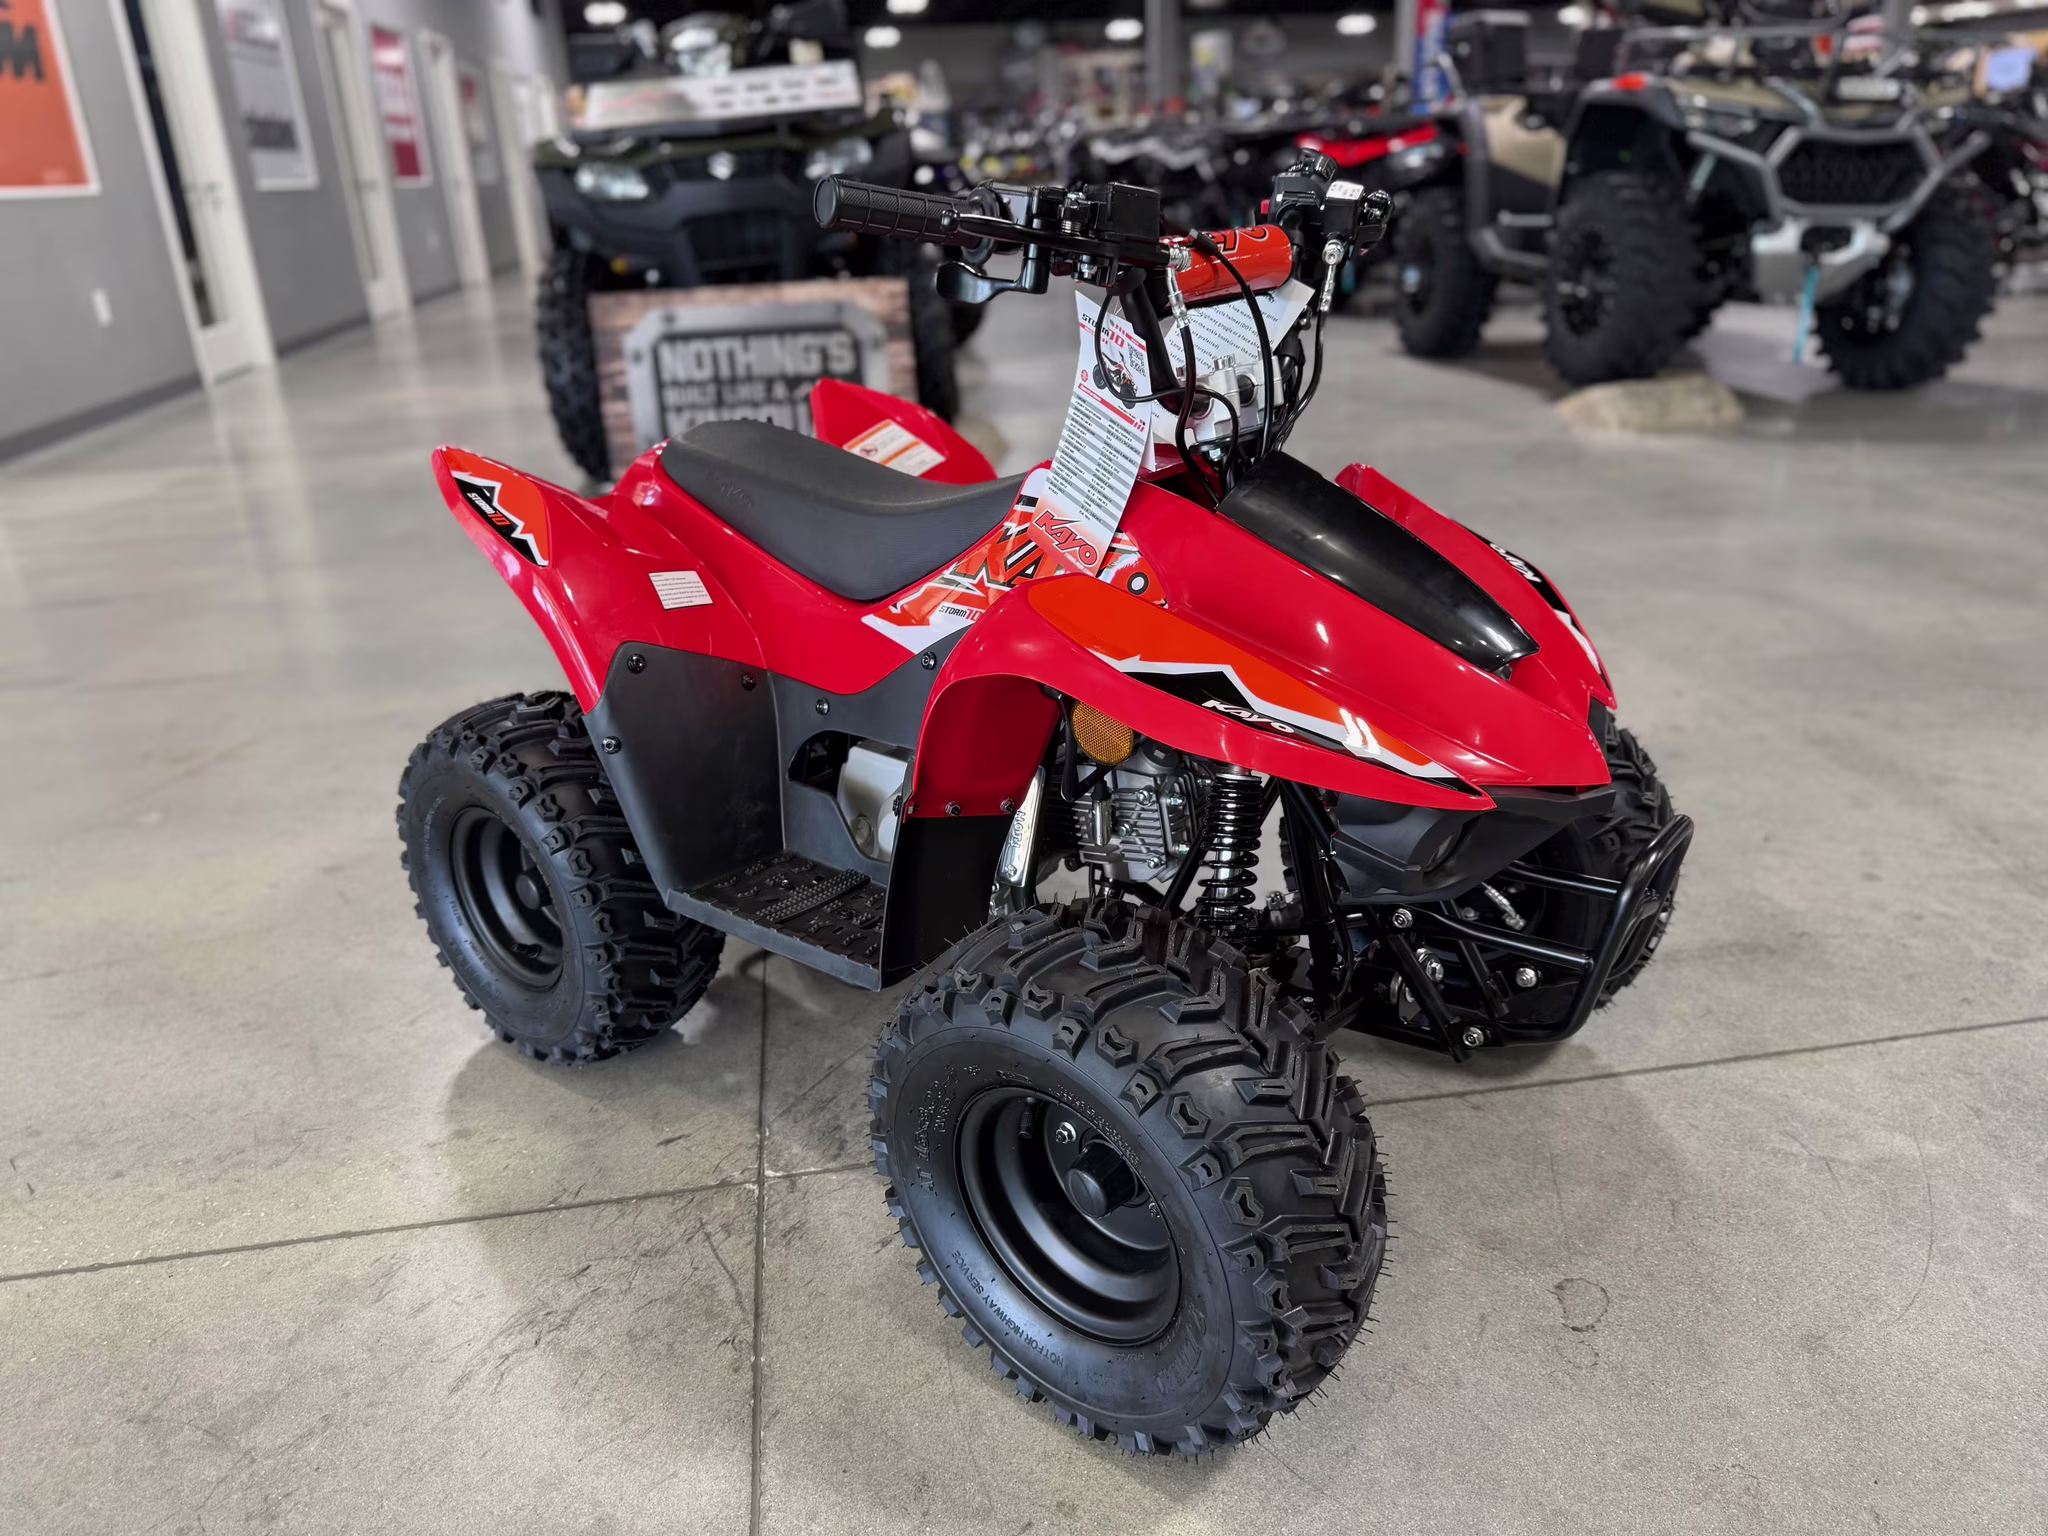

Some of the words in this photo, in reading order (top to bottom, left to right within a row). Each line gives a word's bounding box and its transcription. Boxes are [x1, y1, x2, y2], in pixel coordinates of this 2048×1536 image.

[1034, 508, 1098, 566] KAYO
[1201, 699, 1295, 734] KAYO
[952, 1250, 984, 1294] SERVICE
[982, 1295, 1025, 1338] HIGHWAY
